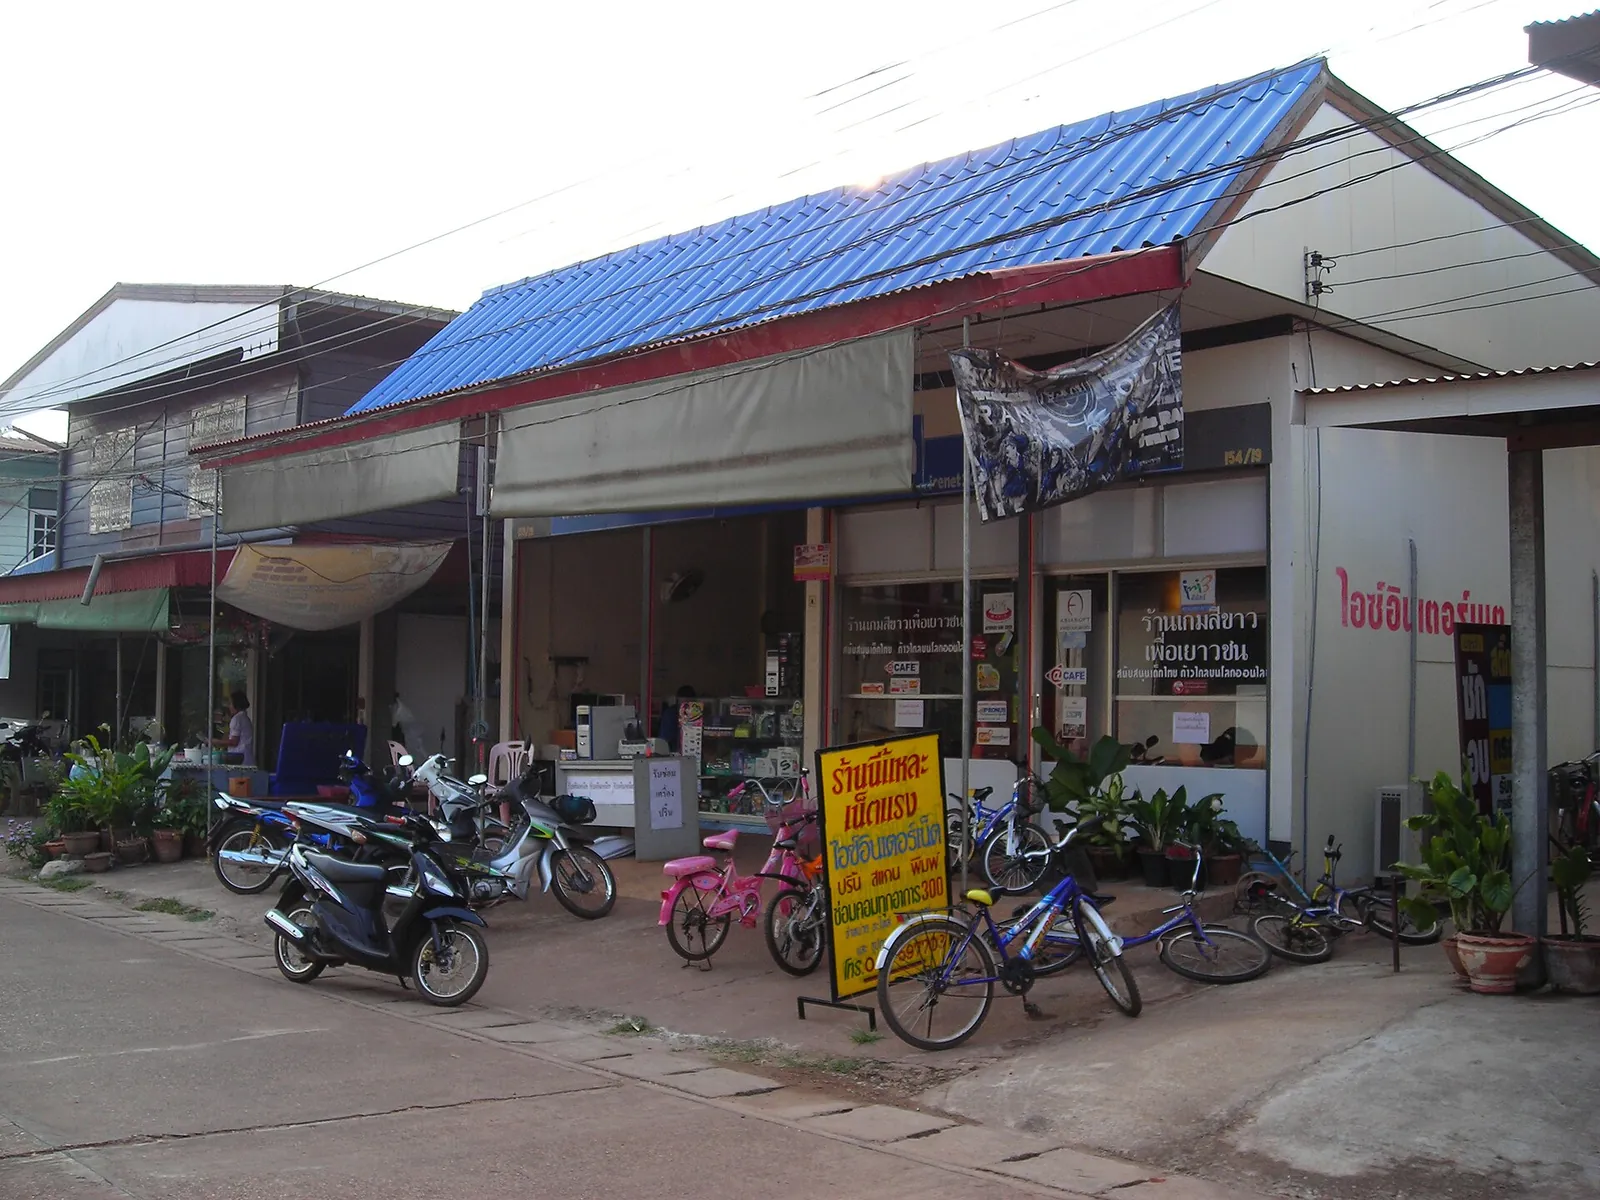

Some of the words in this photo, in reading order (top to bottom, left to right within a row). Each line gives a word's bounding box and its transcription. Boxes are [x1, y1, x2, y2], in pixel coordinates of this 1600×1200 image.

[1141, 606, 1258, 632] ร้านเกมสีขาว
[898, 640, 964, 654] ก้าวไกลบนโลกออนไล
[1145, 632, 1249, 661] เพื่อเยาวชน
[1116, 663, 1178, 682] สนับสนุนเด็กไทย
[831, 747, 929, 795] ร้านนี้แหละ
[844, 791, 918, 832] เน็ตแรง
[837, 871, 862, 896] ปริ้น
[872, 866, 901, 887] สแกน
[910, 852, 941, 876] พิมพ์
[833, 885, 921, 927] ซ่อมคอมทุกอาการ
[921, 876, 944, 901] 300
